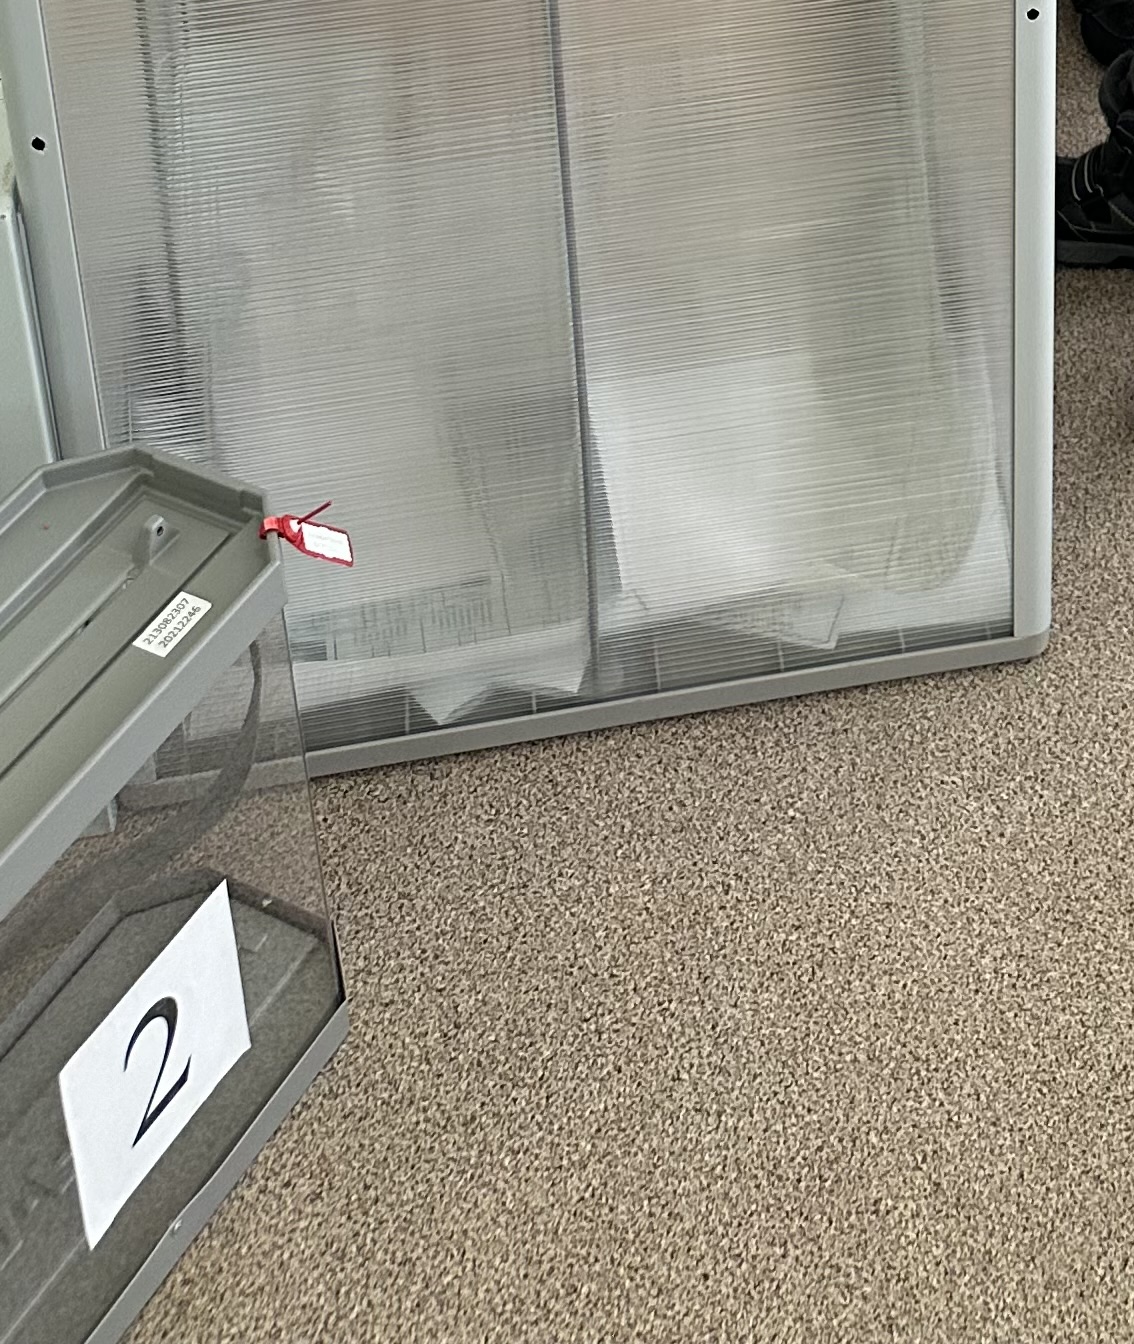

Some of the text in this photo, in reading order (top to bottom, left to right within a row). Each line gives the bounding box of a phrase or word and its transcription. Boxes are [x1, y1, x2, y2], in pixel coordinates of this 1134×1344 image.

[142, 597, 190, 645] 213082307
[158, 605, 202, 648] 20212246
[123, 995, 192, 1149] 2
